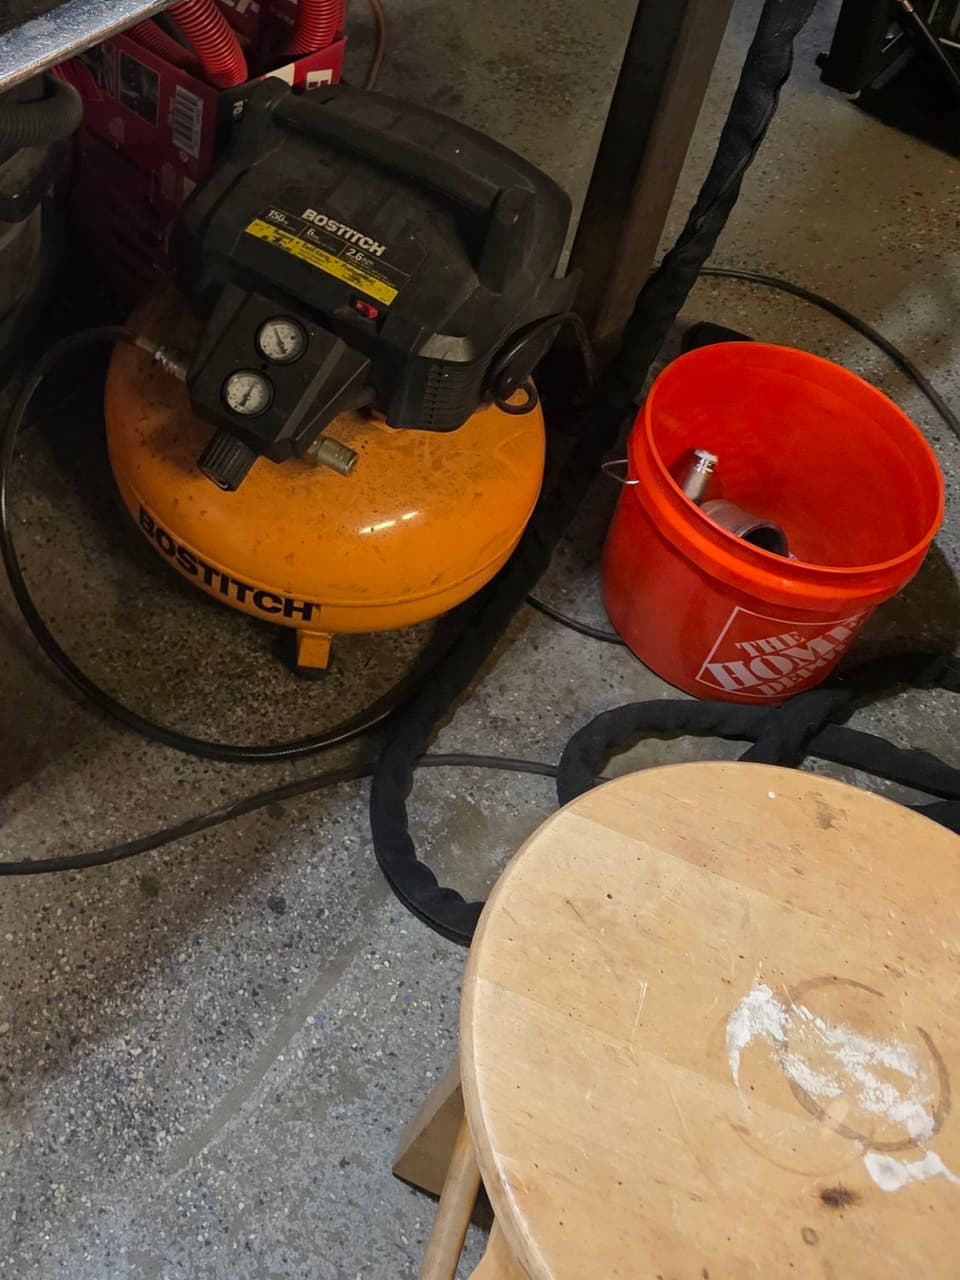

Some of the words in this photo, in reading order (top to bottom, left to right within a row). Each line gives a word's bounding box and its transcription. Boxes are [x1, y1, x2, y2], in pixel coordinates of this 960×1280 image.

[300, 207, 387, 258] BOSTITCH
[345, 247, 365, 262] 2.6
[138, 503, 314, 623] BOSTITCH
[735, 630, 807, 658] THE
